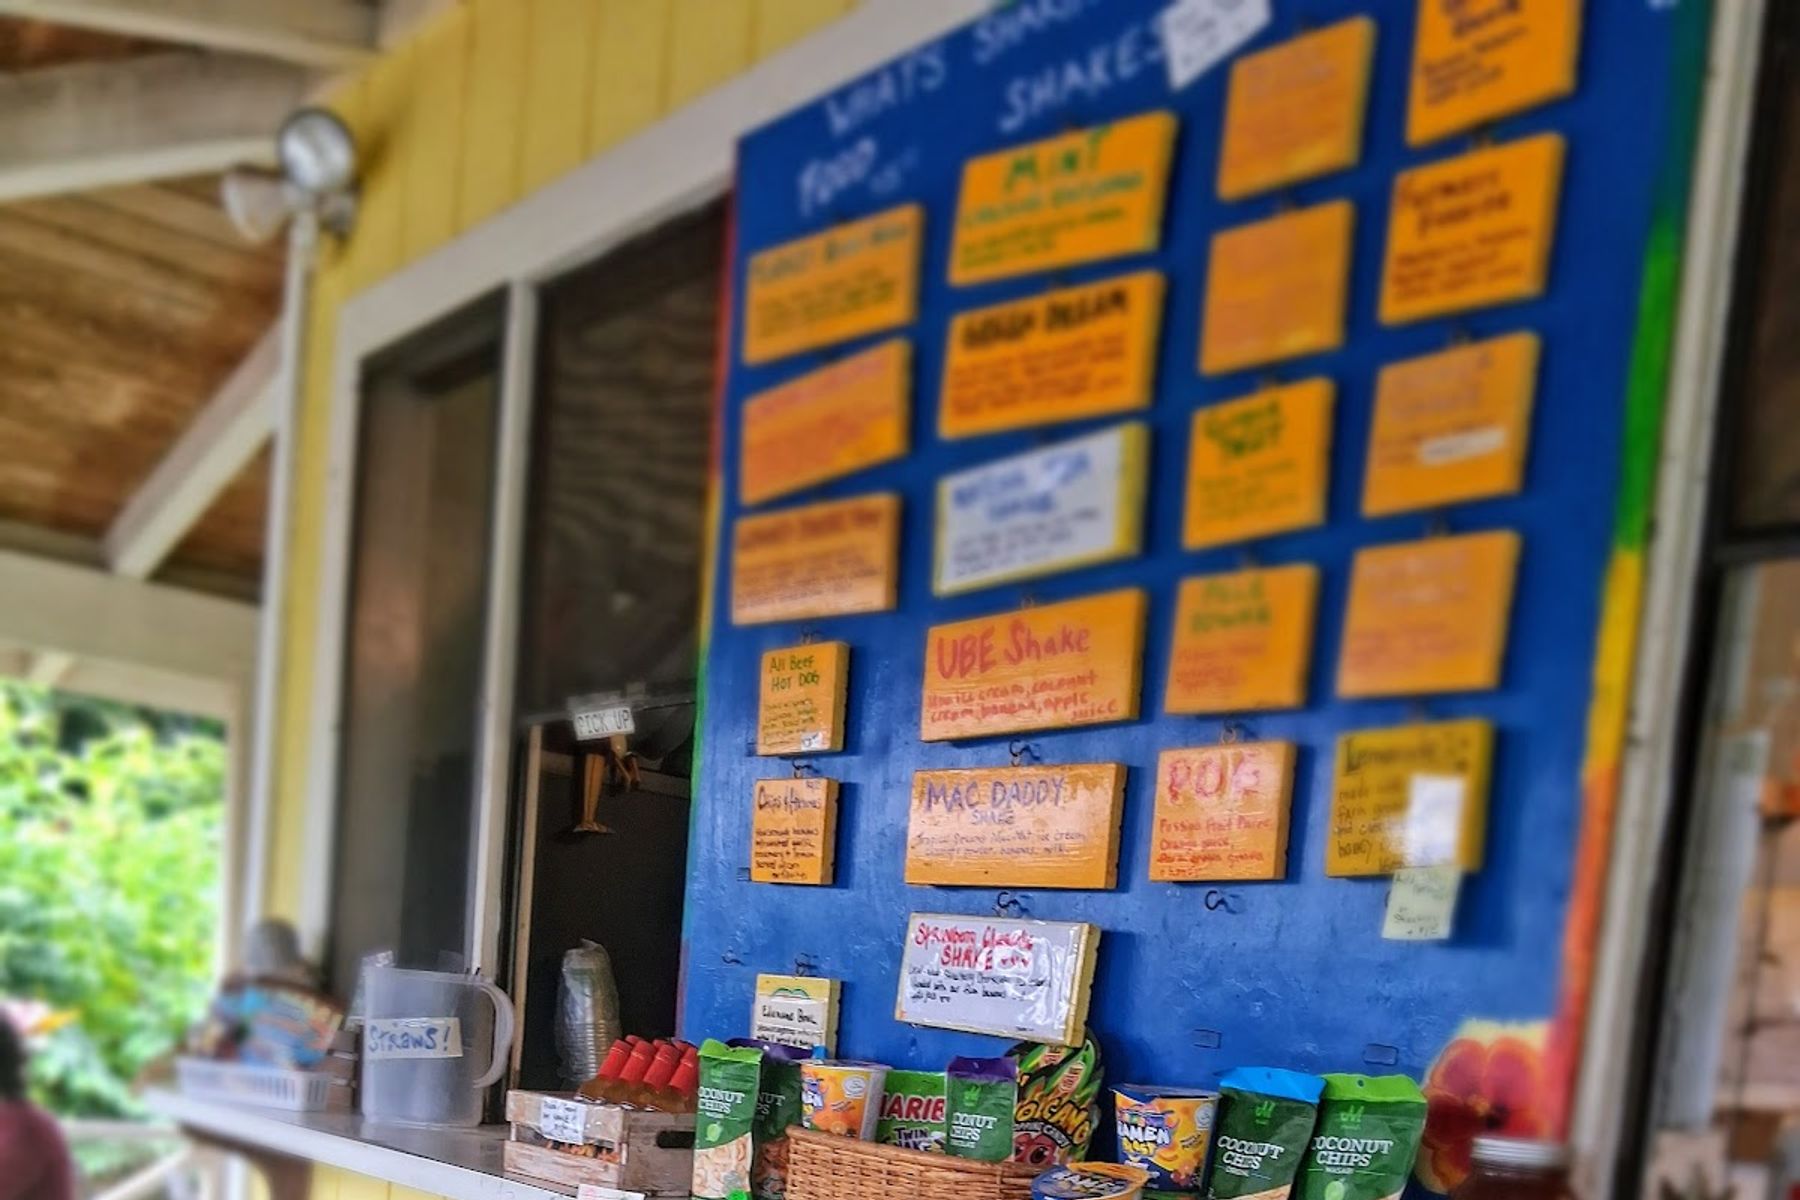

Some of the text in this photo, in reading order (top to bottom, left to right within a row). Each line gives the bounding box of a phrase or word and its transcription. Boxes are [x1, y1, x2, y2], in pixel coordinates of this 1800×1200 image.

[935, 616, 1091, 680] UBE Shake
[925, 775, 1065, 813] MAC DADDY
[697, 1086, 746, 1105] OCONUT
[1015, 1092, 1093, 1146] OLCANO
[1217, 1135, 1285, 1160] COCONUT
[1222, 1150, 1263, 1170] CHIPS
[1315, 1150, 1373, 1167] CHIPS
